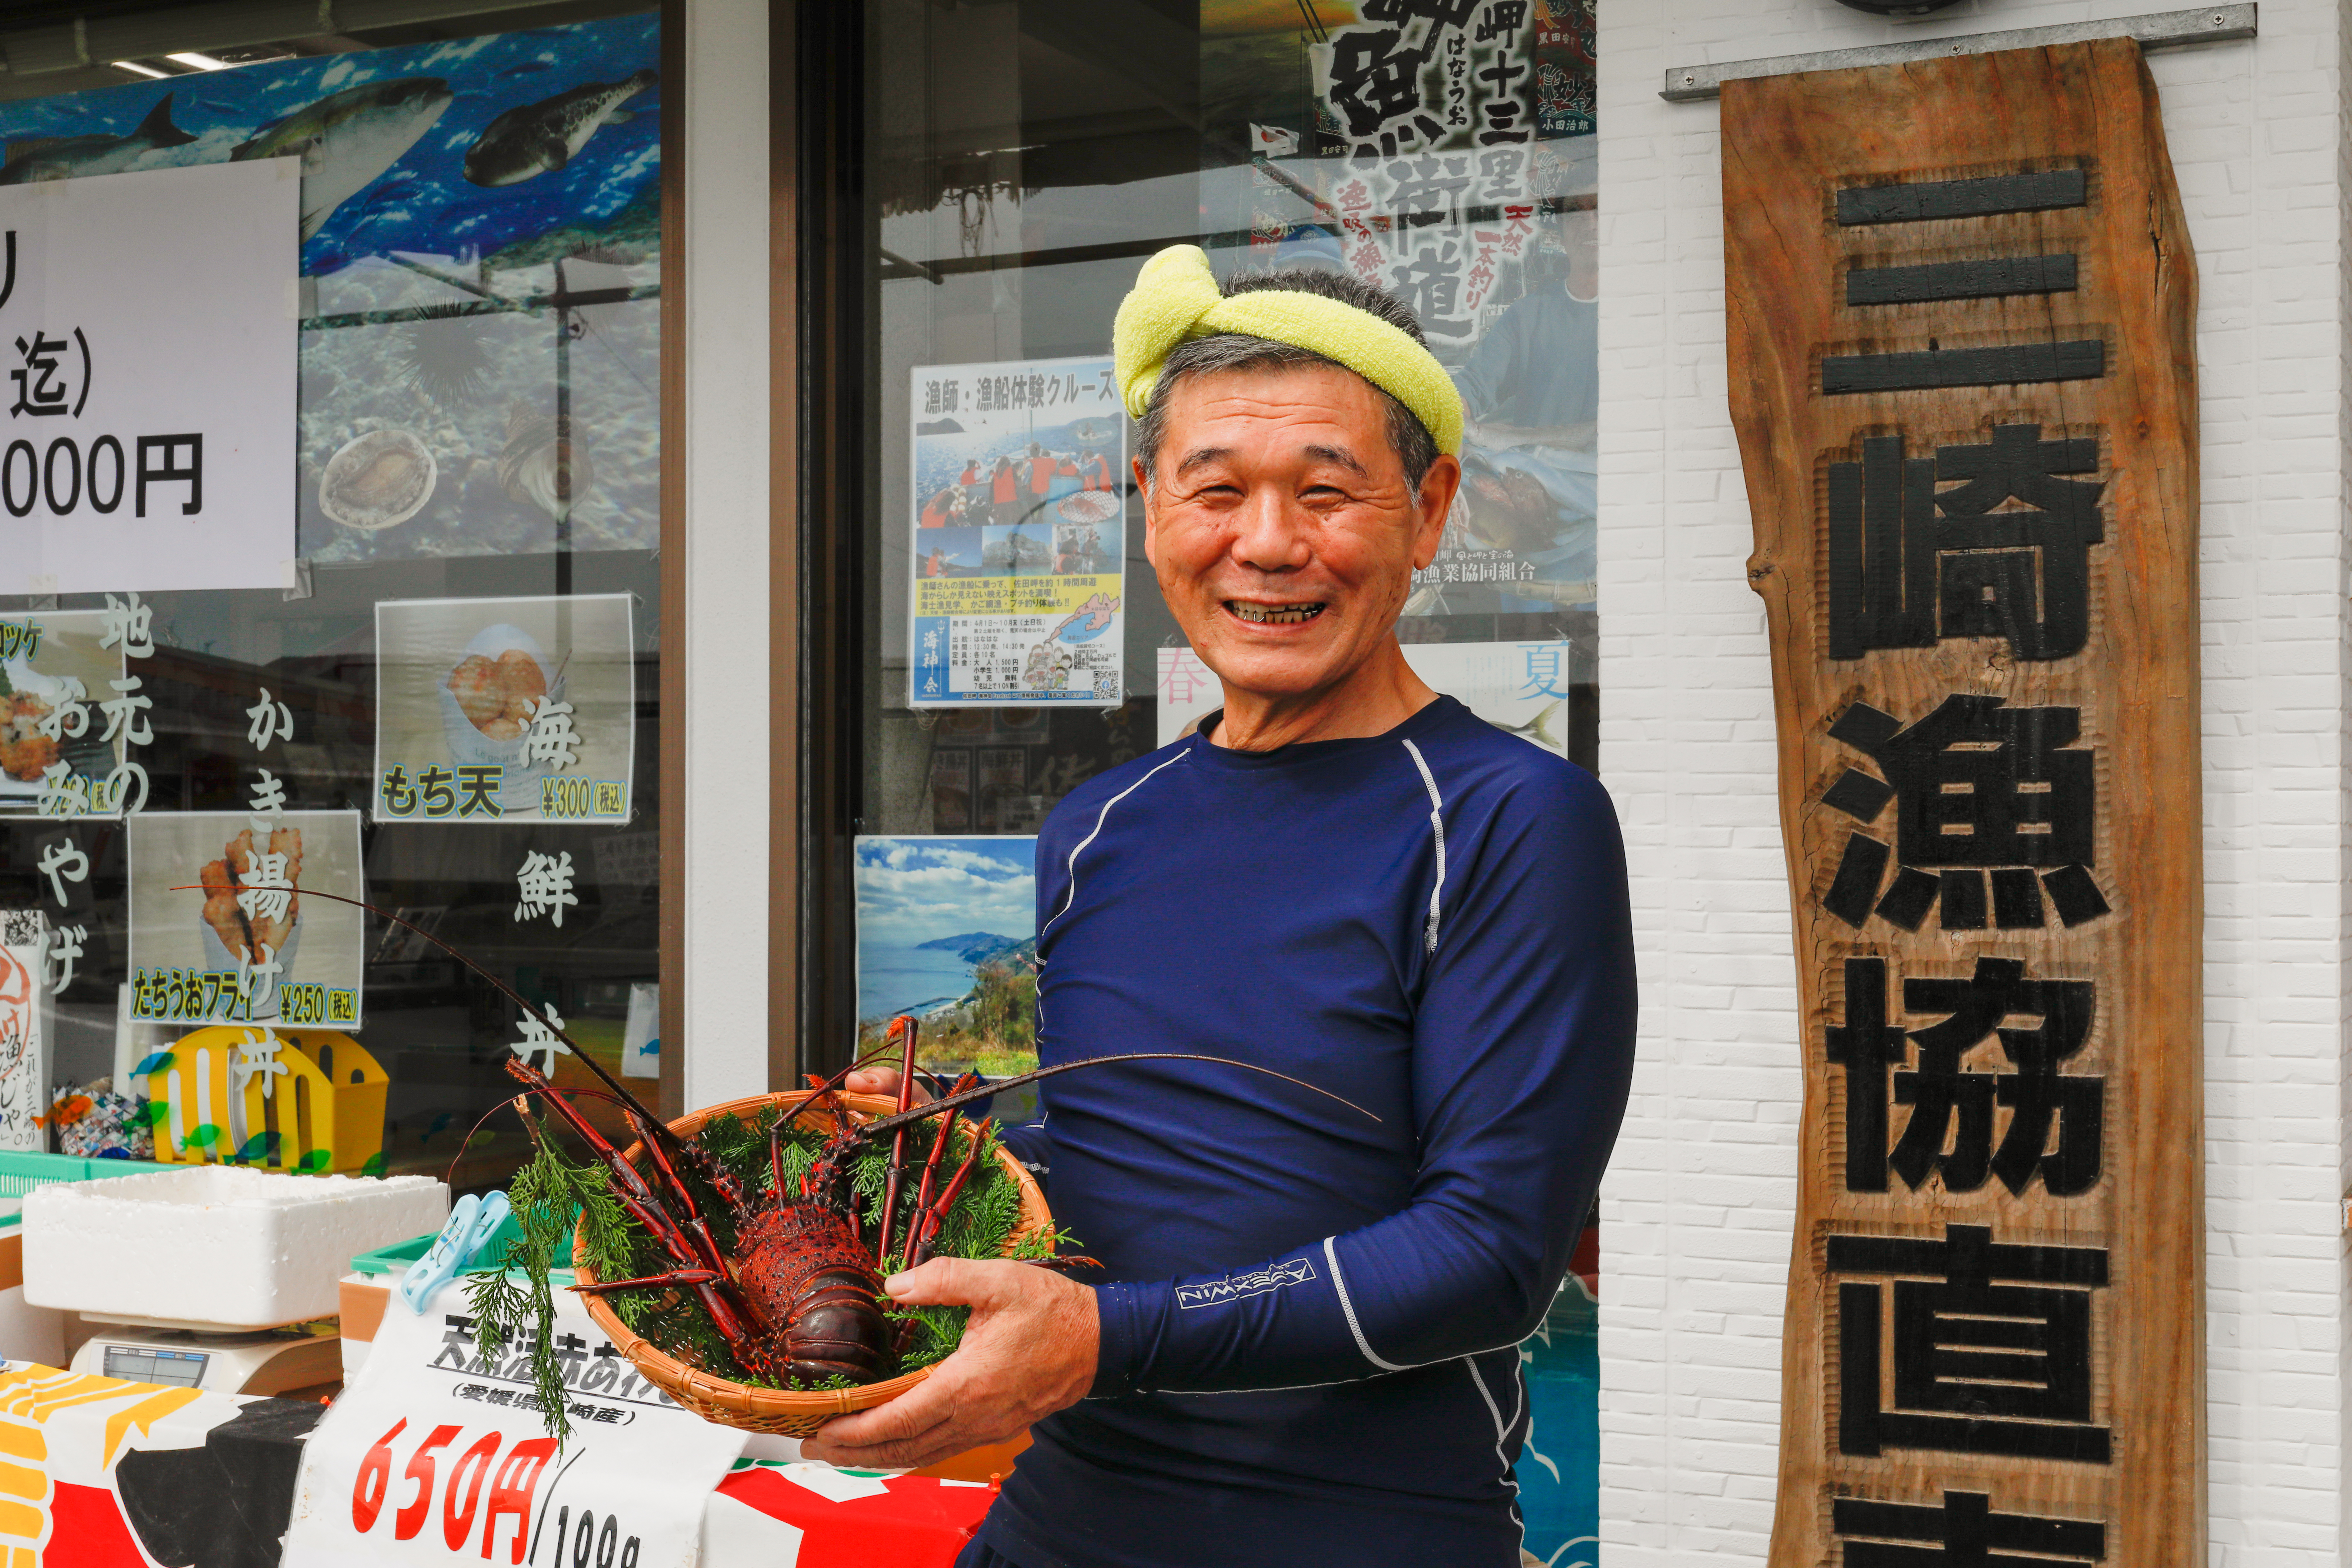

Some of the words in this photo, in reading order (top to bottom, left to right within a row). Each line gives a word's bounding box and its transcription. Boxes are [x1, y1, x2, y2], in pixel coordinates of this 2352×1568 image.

[1446, 33, 1467, 126] はなうお
[1543, 119, 1589, 132] 小田治郎
[10, 326, 92, 419] 迄)
[925, 369, 1115, 414] 漁師・漁船体験クルーズ
[2, 432, 204, 518] 000円
[1456, 550, 1514, 560] 風と岬と宝の海
[0, 618, 43, 659] ッケ
[1157, 647, 1208, 705] 春
[1516, 640, 1569, 700] 夏
[99, 592, 154, 818] 地元の
[382, 766, 502, 818] もち天
[37, 676, 90, 995] おみやげ
[234, 687, 293, 1098] かき揚げ丼
[510, 695, 581, 1079] 海鮮丼
[133, 969, 256, 1020] たちうおフライ
[452, 1383, 636, 1425] (愛媛県崎産)
